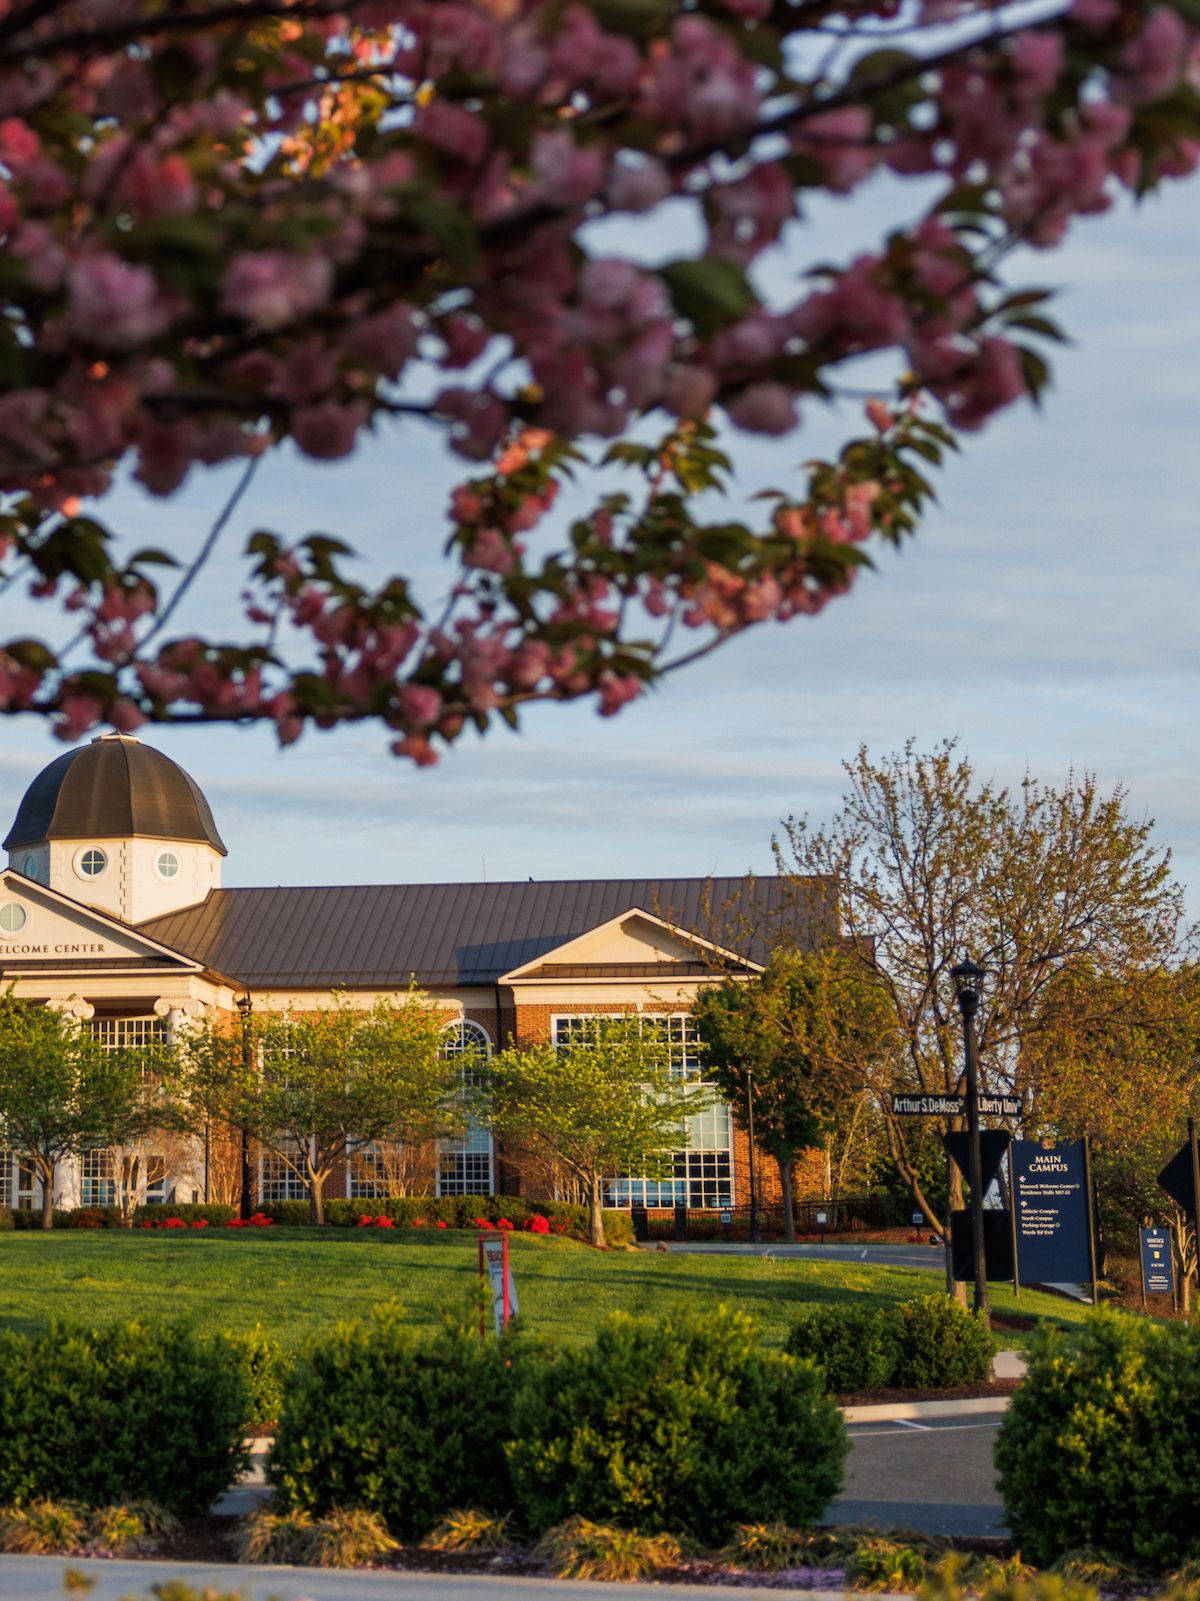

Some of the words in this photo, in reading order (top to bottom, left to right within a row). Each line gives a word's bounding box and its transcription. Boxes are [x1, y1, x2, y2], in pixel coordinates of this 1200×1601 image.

[54, 943, 105, 953] CENTER
[894, 1097, 920, 1113] Arthur
[977, 1097, 1002, 1115] Liberty
[1003, 1098, 1018, 1114] Univ
[1035, 1155, 1061, 1163] MAIN
[1029, 1163, 1068, 1172] CAMPUS
